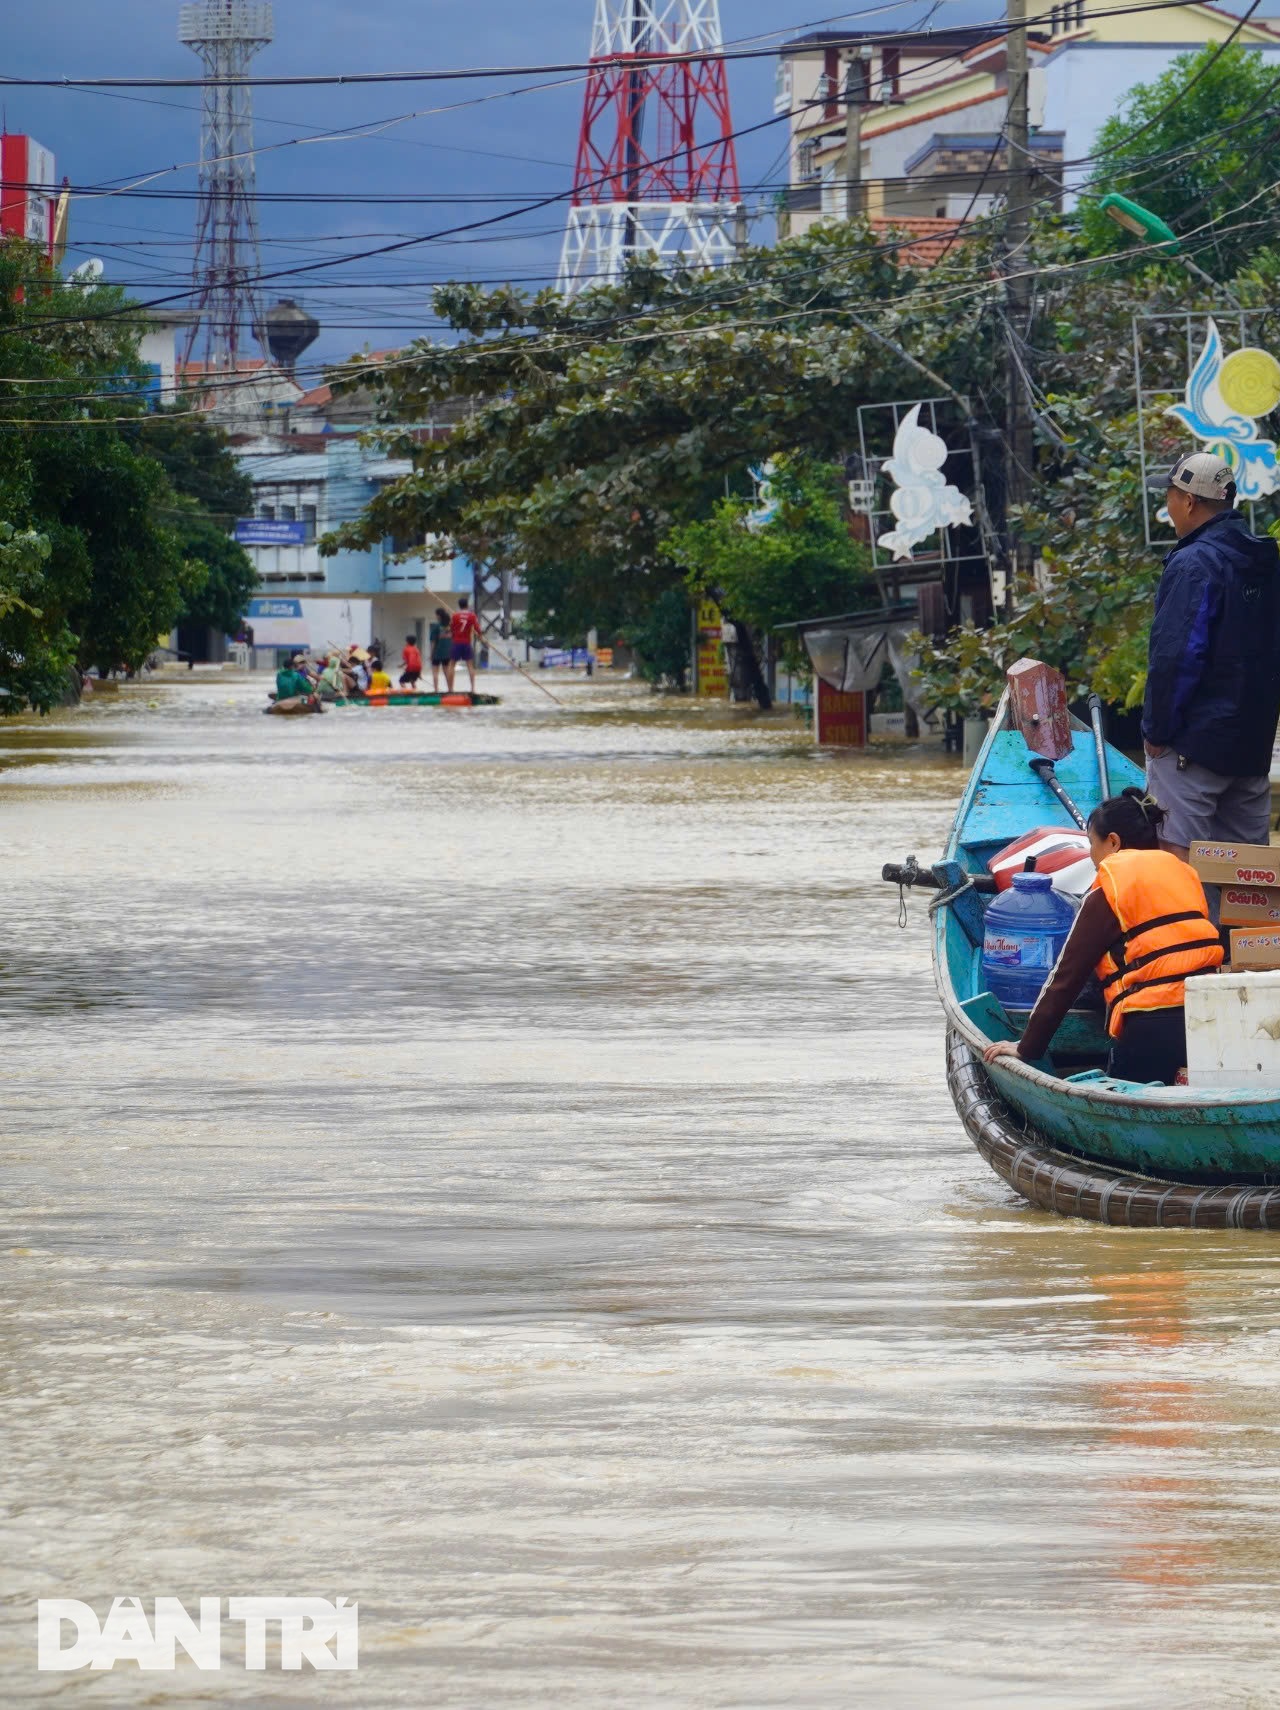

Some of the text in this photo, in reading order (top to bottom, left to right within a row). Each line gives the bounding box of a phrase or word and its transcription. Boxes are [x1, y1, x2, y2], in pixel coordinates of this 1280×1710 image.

[459, 618, 468, 632] 7
[1236, 868, 1276, 883] Gấu Đỏ
[1226, 891, 1251, 905] Gấu
